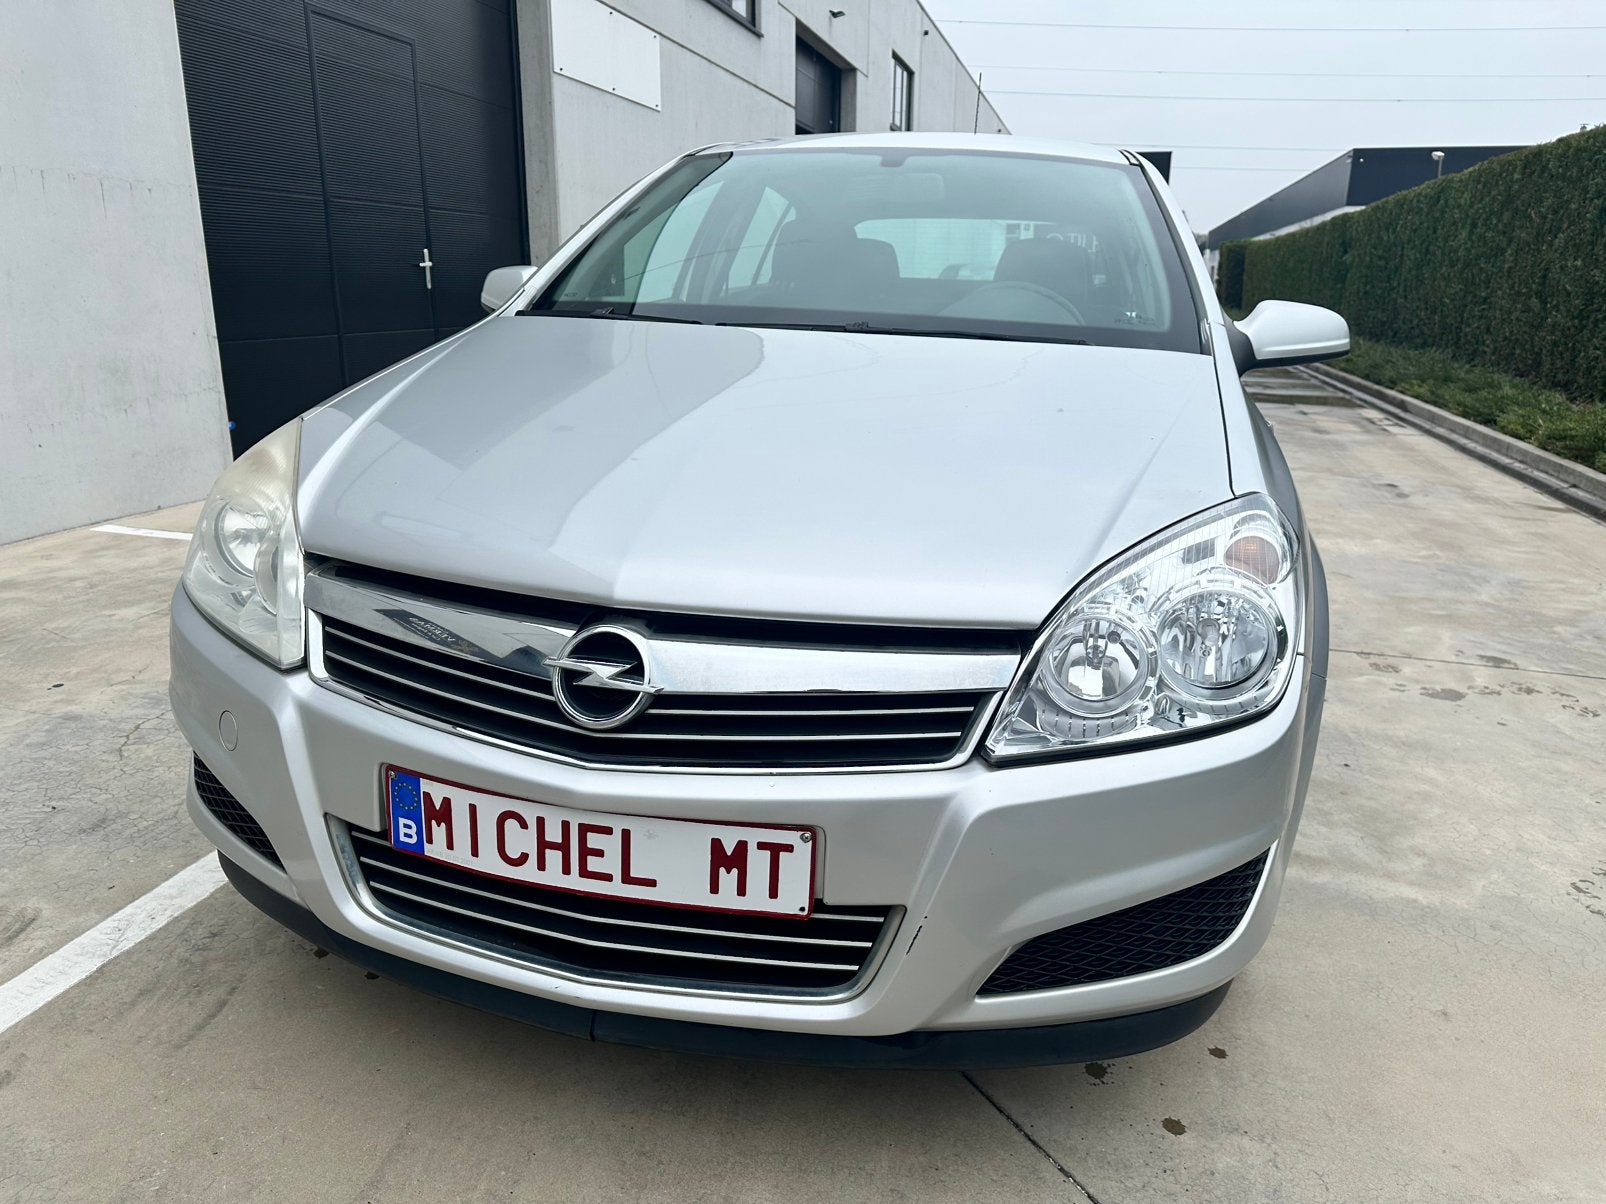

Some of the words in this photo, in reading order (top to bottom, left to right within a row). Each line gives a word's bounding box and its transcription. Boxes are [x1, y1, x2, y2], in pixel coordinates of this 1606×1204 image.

[398, 817, 418, 844] B
[422, 790, 657, 888] MICHEL
[709, 837, 795, 900] MT
